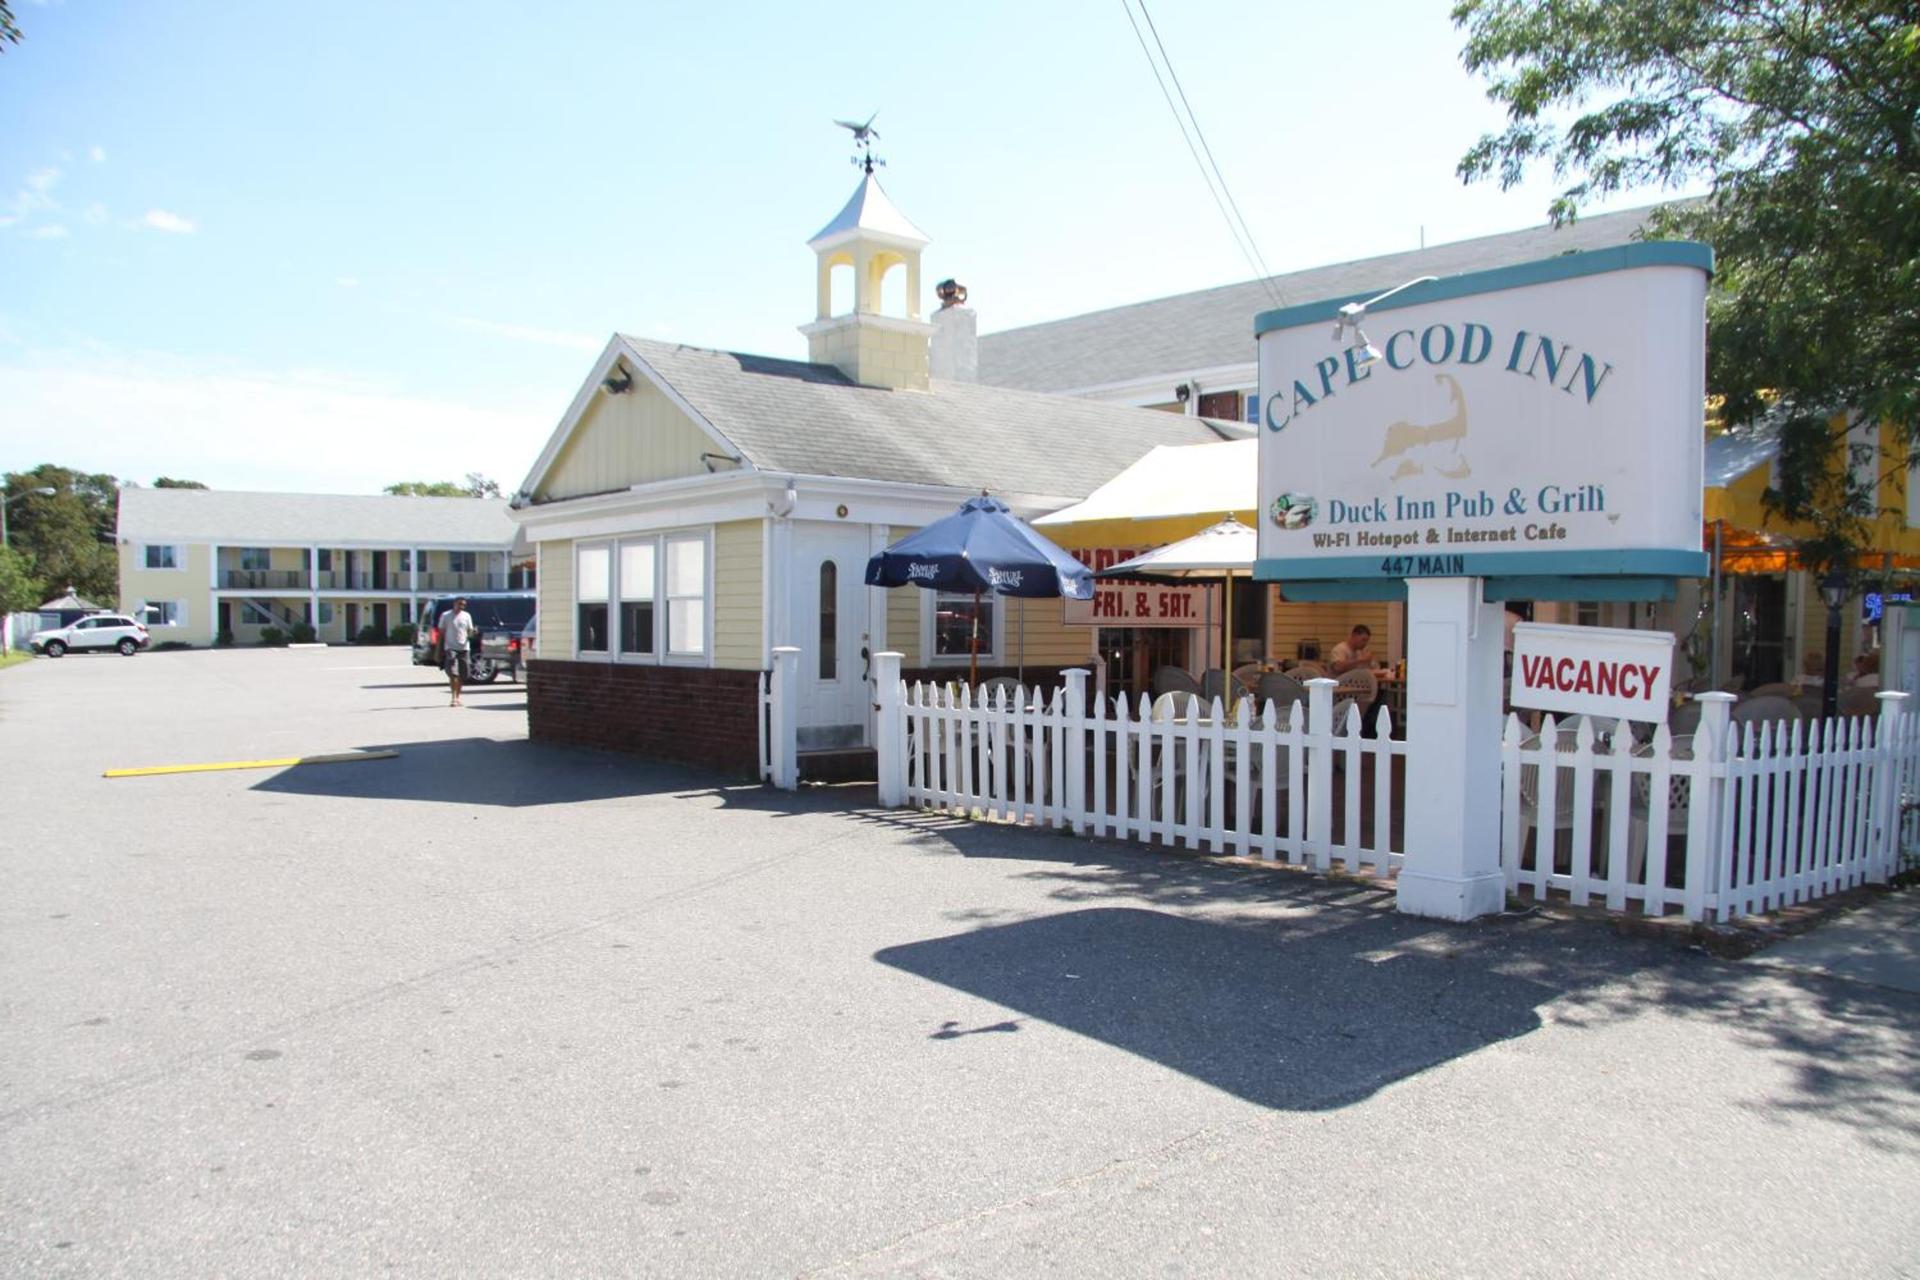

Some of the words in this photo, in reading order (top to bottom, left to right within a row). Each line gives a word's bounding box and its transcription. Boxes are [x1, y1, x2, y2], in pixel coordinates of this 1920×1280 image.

[1265, 343, 1372, 433] CAPE
[1385, 323, 1492, 370] COD
[1505, 330, 1614, 405] INN
[1329, 497, 1387, 524] Duck
[1396, 494, 1435, 521] Inn
[1446, 490, 1494, 518] Pub
[1503, 487, 1527, 515] &
[1537, 485, 1605, 514] Grill
[1357, 529, 1419, 548] Hotspot
[1425, 528, 1440, 544] &
[1447, 525, 1516, 544] Internet
[1524, 522, 1567, 541] Cafe
[1381, 557, 1413, 575] 447
[1418, 555, 1464, 575] MAIN
[1093, 591, 1129, 618] FRI.
[1135, 592, 1151, 617] &
[1159, 593, 1196, 617] SAT.
[1521, 654, 1661, 701] VACANCY
